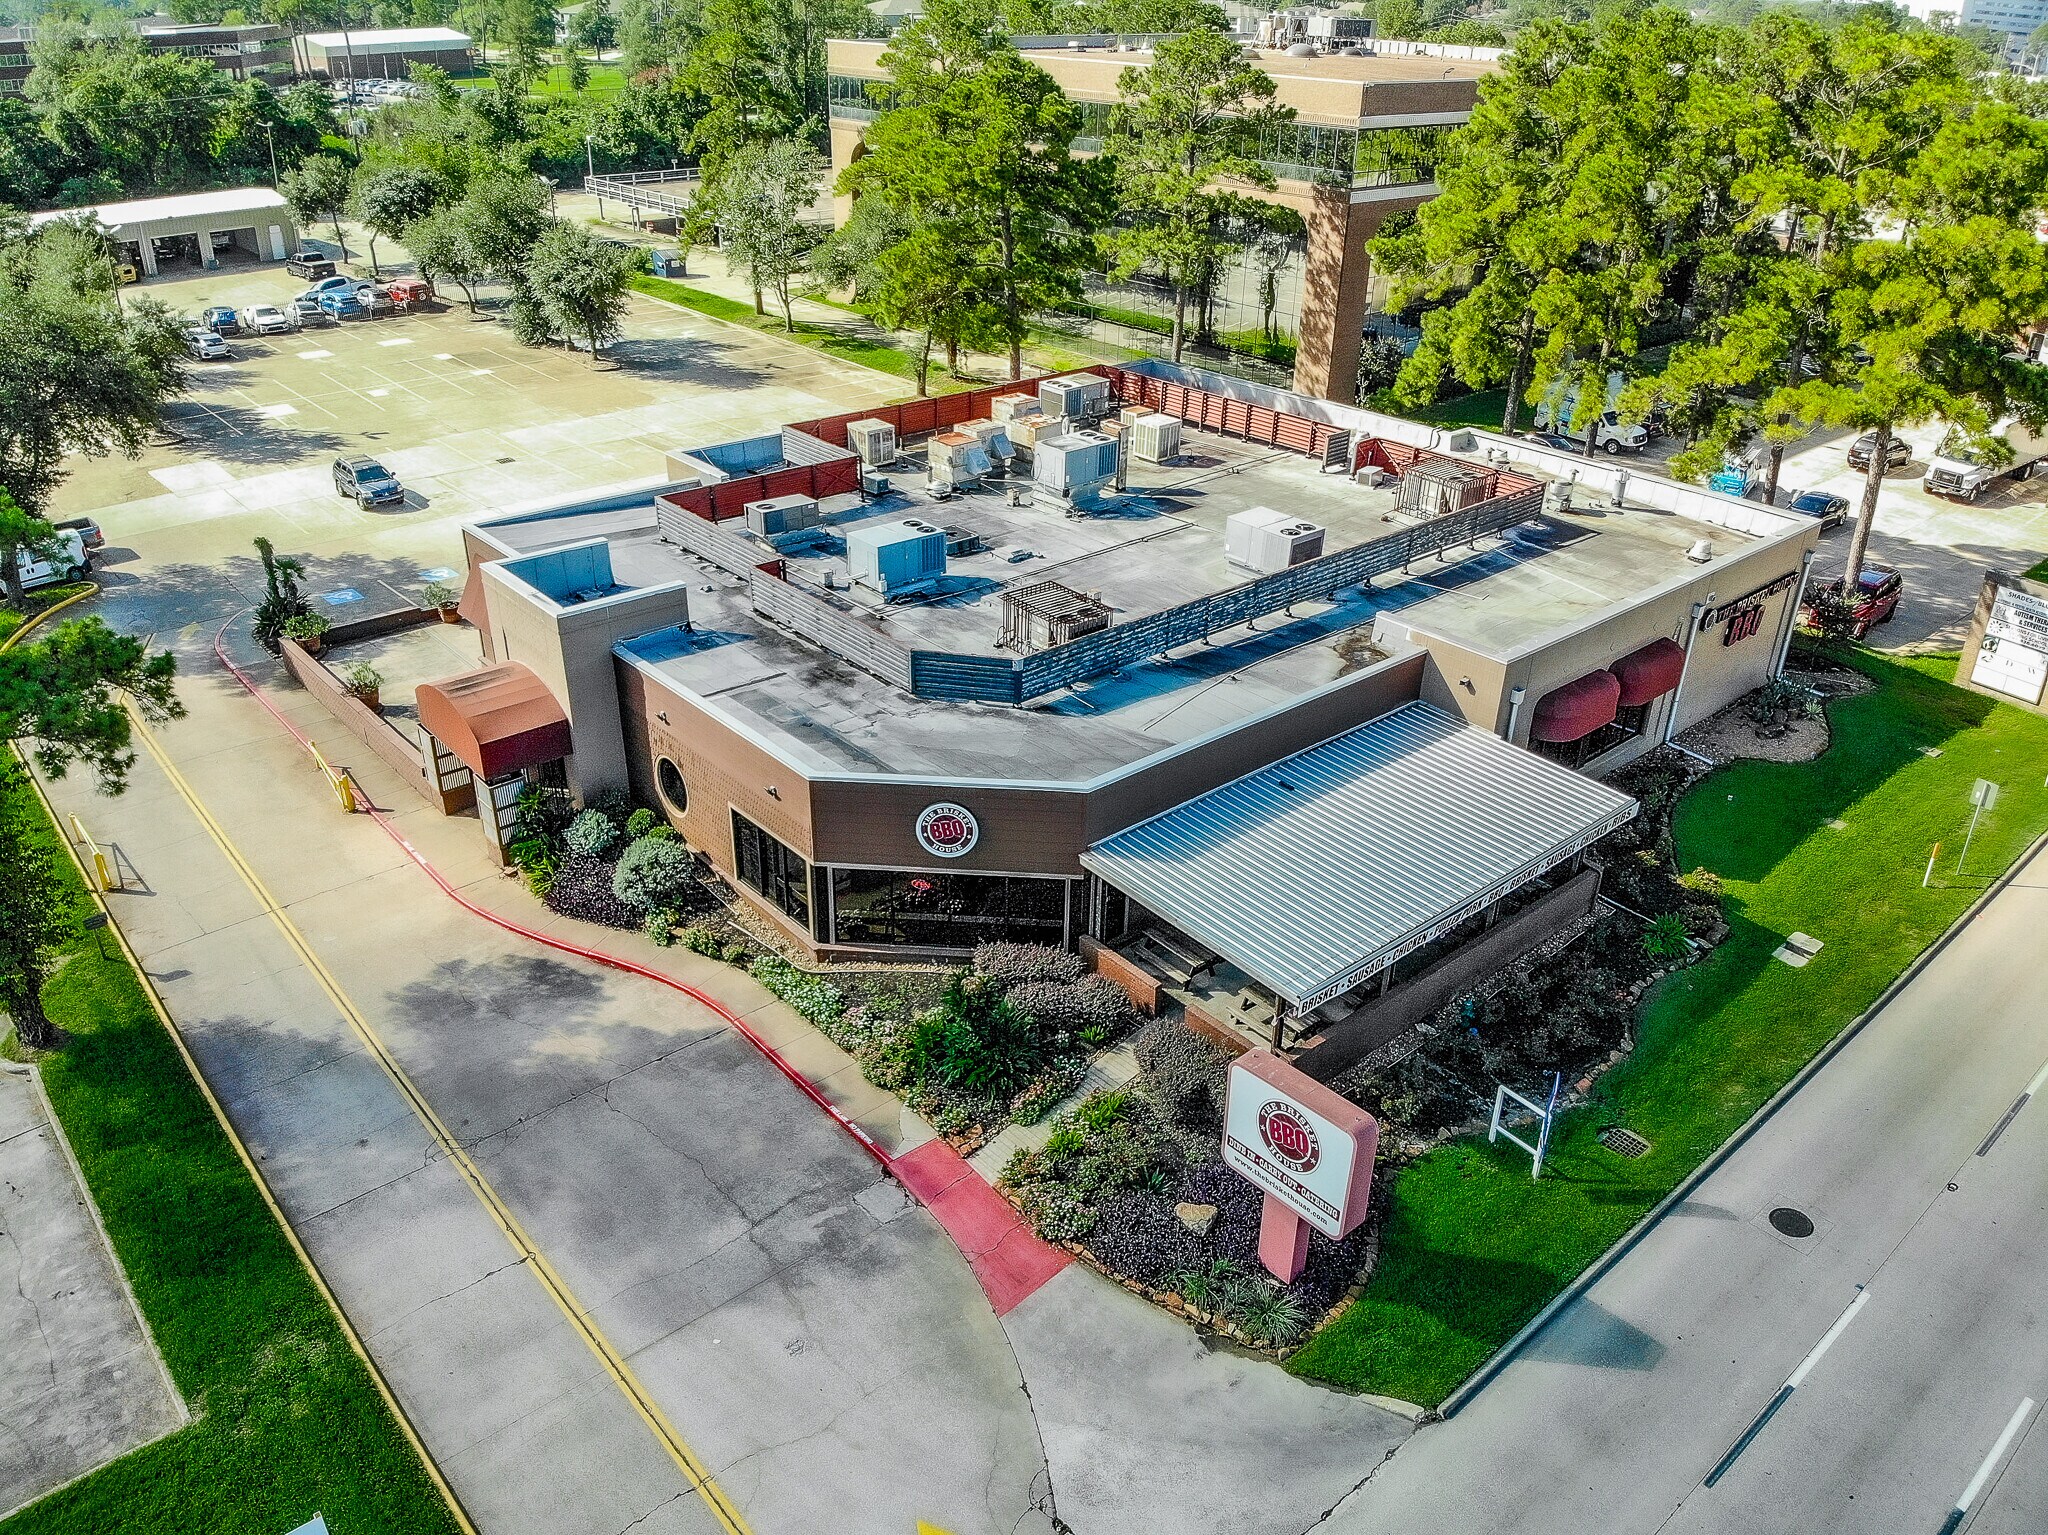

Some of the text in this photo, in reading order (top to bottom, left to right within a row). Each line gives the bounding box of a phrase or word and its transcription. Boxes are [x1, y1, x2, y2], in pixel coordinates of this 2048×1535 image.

[2008, 591, 2033, 603] SHADES
[2014, 610, 2034, 621] AUTISM
[2023, 620, 2048, 633] SERVICES
[922, 808, 972, 828] THE BRISKET
[930, 819, 965, 840] BBQ
[932, 843, 963, 853] HOUSE
[1301, 983, 1340, 1012] BRISKET
[1347, 955, 1386, 988] SAUSAGE
[1393, 931, 1428, 960] CHICKEN
[1510, 867, 1539, 888] BRISKET
[1545, 844, 1577, 868] SAUSAGE
[1611, 809, 1632, 827] RIBS
[1260, 1102, 1319, 1151] THE BRISKET
[1270, 1117, 1309, 1157] BBQ
[1269, 1144, 1304, 1172] HOUSE
[1229, 1137, 1246, 1155] DINE
[1260, 1159, 1282, 1179] CARRY
[1282, 1173, 1298, 1190] OUT
[1301, 1188, 1339, 1219] CATERING
